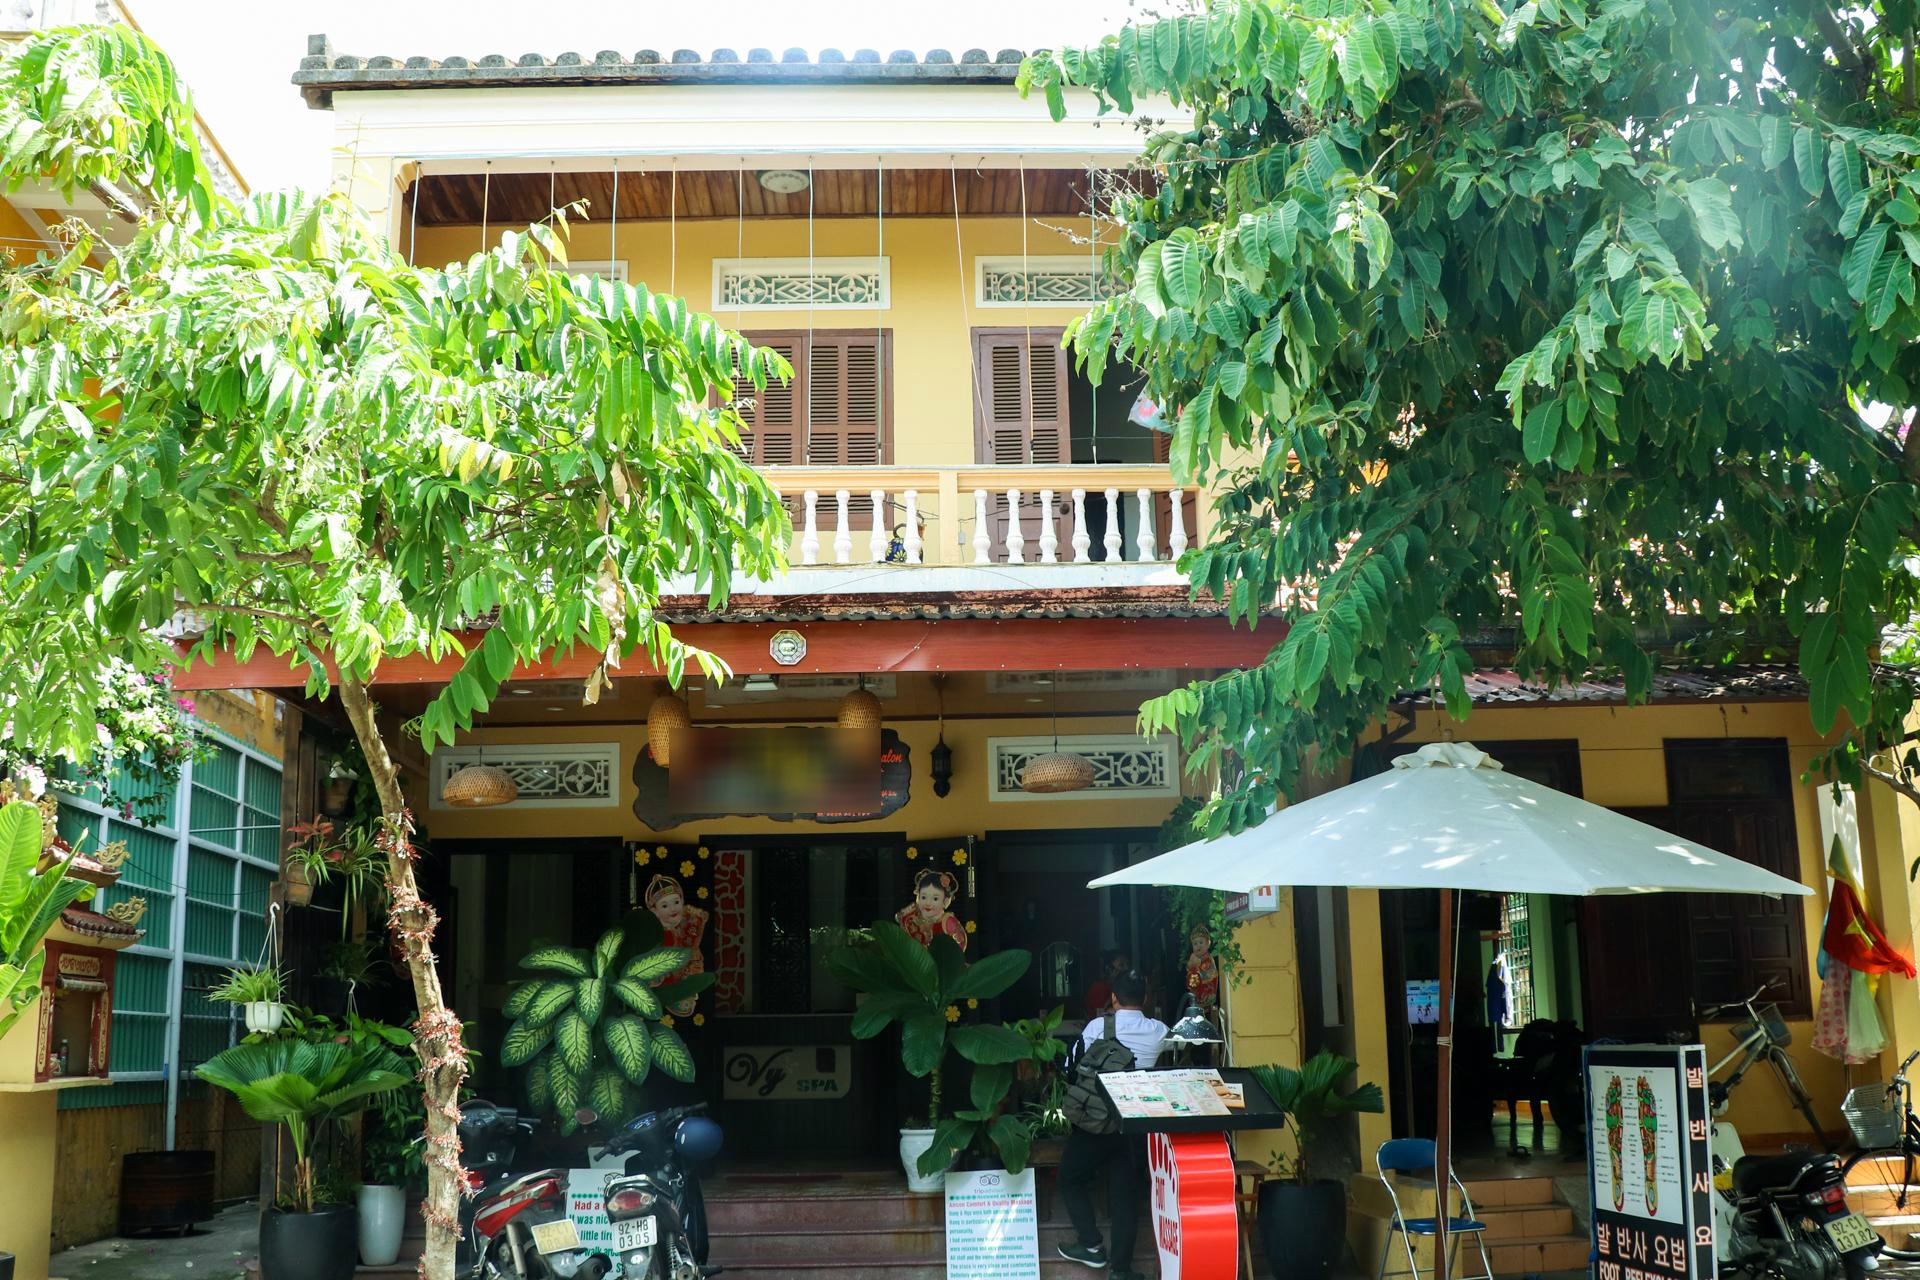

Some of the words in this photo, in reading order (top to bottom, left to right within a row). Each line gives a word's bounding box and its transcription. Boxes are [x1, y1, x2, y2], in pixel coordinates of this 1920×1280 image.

[797, 1079, 838, 1093] SPA
[1156, 1176, 1166, 1212] FOOT
[574, 1201, 592, 1210] Had
[577, 1216, 593, 1224] was
[596, 1214, 608, 1224] nic
[618, 1219, 649, 1236] 92-H8
[580, 1231, 599, 1240] little
[619, 1231, 650, 1249] 0305
[1159, 1215, 1178, 1256] MASSAGE
[1837, 1228, 1875, 1251] 137.82
[1596, 1221, 1611, 1254] 발
[1616, 1226, 1648, 1264] 반사
[1654, 1235, 1687, 1273] 요법
[1599, 1260, 1620, 1280] FOOT
